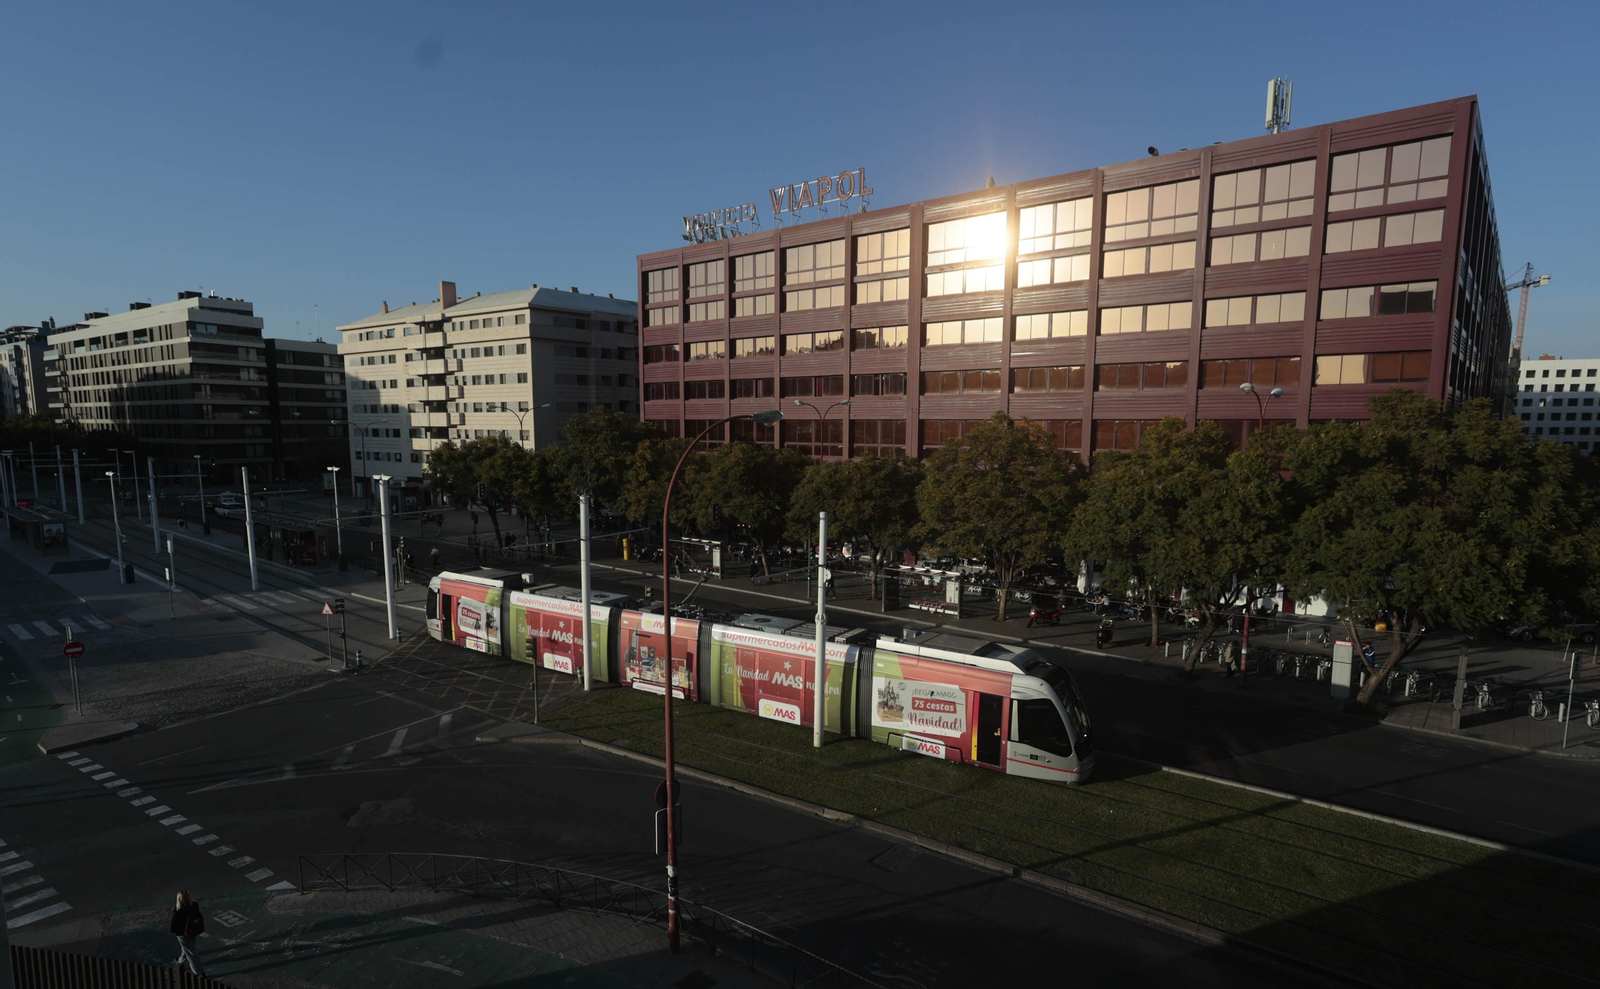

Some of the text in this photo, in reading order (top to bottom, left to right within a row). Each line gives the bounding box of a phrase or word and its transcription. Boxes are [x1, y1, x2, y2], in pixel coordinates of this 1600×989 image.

[685, 202, 756, 231] EDIFICIO
[769, 167, 874, 214] VIAPOL
[518, 623, 526, 633] La
[527, 624, 550, 638] Navidad
[551, 629, 573, 645] MAS
[554, 659, 570, 671] MAS
[723, 662, 841, 696] La Navidad MAS nutra
[914, 700, 954, 711] 75 cestas
[773, 707, 796, 721] MAS
[908, 712, 962, 731] Navidad!
[917, 741, 941, 755] MAS
